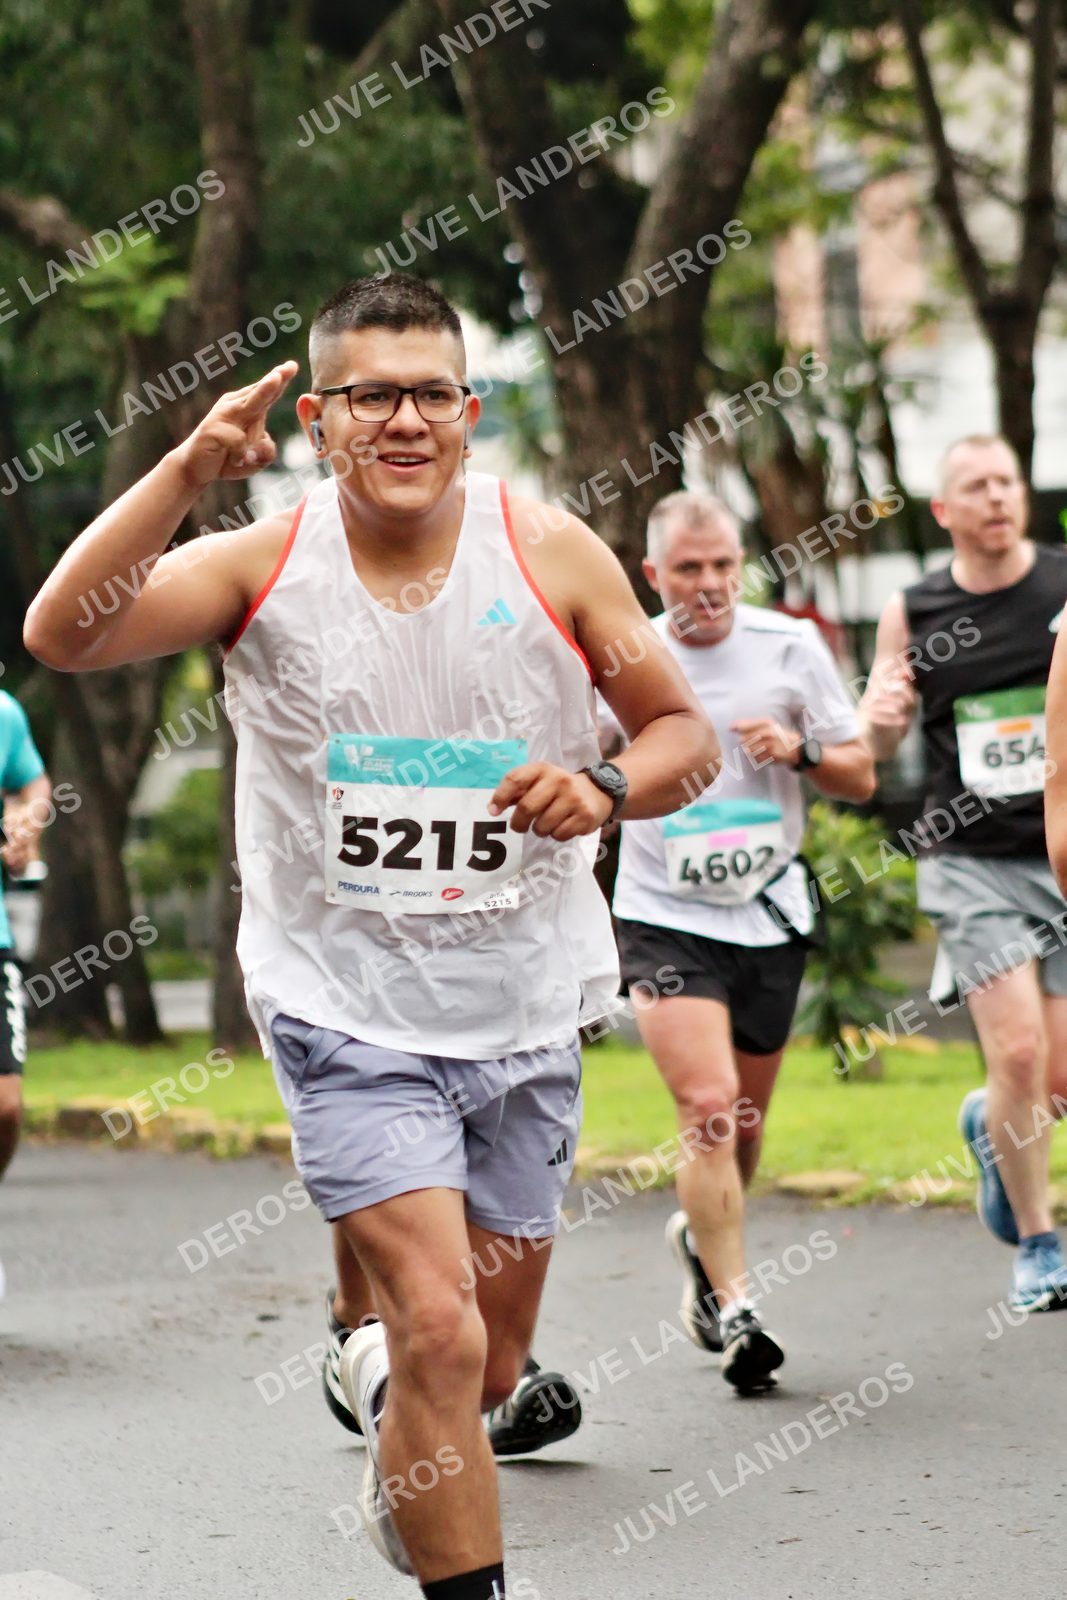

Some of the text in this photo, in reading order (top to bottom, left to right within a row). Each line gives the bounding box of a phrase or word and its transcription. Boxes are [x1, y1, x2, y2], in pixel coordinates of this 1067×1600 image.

[337, 815, 507, 872] 5215
[337, 880, 380, 895] PERDURA
[402, 890, 433, 898] BROOKS
[484, 898, 512, 908] 5215
